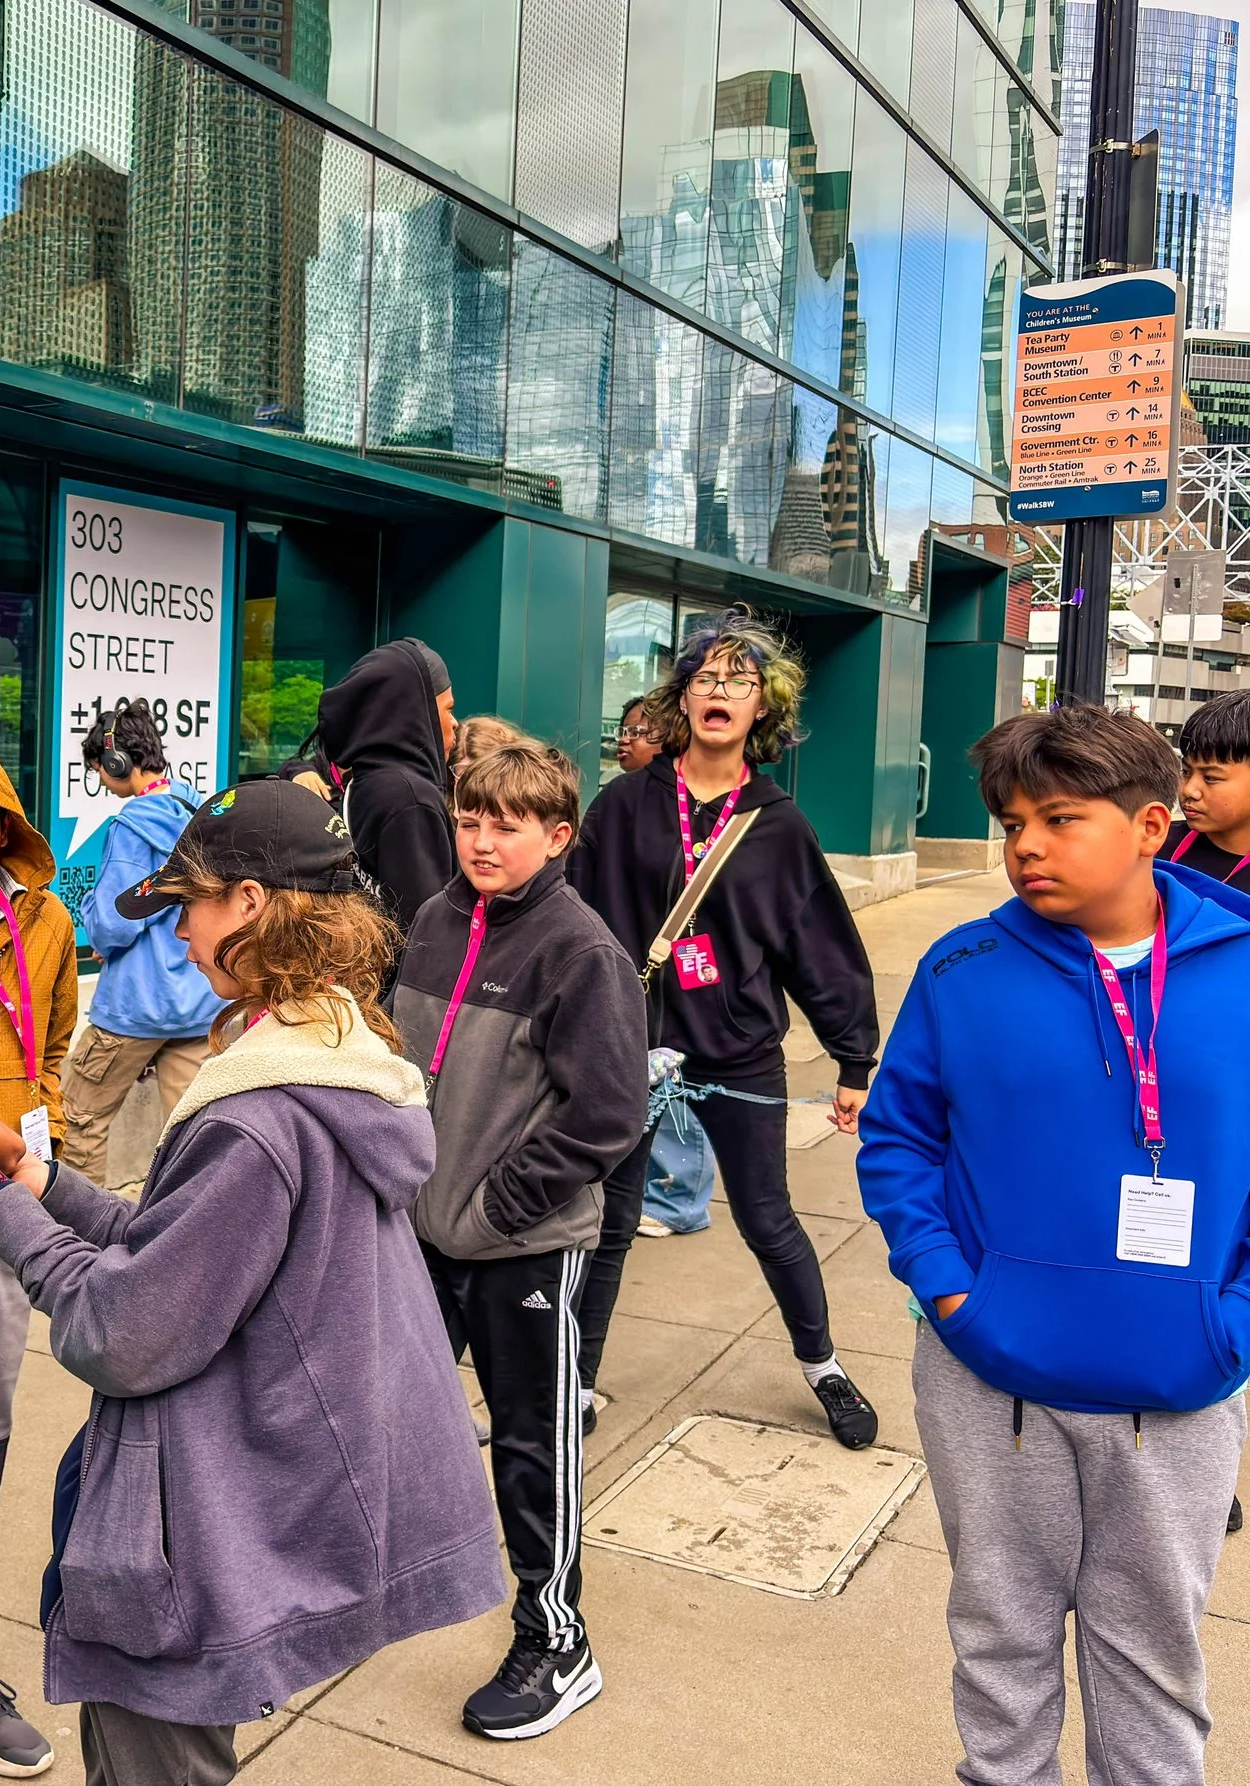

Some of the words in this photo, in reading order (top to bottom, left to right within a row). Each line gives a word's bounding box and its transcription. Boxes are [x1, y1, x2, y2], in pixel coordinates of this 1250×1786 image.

[1026, 310, 1044, 319] YOU
[1045, 307, 1061, 316] ARE
[1062, 306, 1073, 314] AT
[1075, 304, 1090, 312] THE
[1025, 318, 1061, 328] Children's
[1062, 314, 1092, 322] Museum
[1158, 322, 1163, 330] 1
[1025, 336, 1042, 345] Tea
[1044, 333, 1070, 345] Party
[1147, 332, 1162, 340] MIN
[1024, 344, 1066, 356] Museum
[1155, 350, 1161, 359] 7
[1024, 358, 1078, 372] Downtown
[1146, 359, 1161, 367] MIN
[1023, 371, 1051, 382] South
[1053, 367, 1089, 378] Station
[1153, 376, 1160, 385] 9
[1022, 387, 1047, 398] BCEC
[1145, 386, 1160, 394] MIN
[1022, 397, 1077, 408] Convention
[1079, 392, 1112, 402] Center
[1148, 403, 1158, 412] 14
[1021, 411, 1075, 424] Downtown
[1144, 413, 1158, 421] MIN
[1021, 422, 1062, 433] Crossing
[1147, 431, 1158, 440] 16
[1020, 438, 1081, 451] Government
[1082, 436, 1100, 446] Ctr.
[1142, 440, 1157, 448] MIN
[1056, 448, 1076, 456] Green
[1078, 446, 1092, 454] Line
[1019, 465, 1047, 475] North
[1048, 461, 1084, 472] Station
[1145, 458, 1156, 467] 25
[1141, 467, 1156, 475] MIN
[1018, 474, 1044, 483] Orange
[1018, 480, 1053, 489] Commuter
[1073, 475, 1099, 484] Amtrak
[1017, 500, 1055, 510] #WalkSBW
[71, 510, 123, 555] 303
[70, 571, 214, 624] CONGRESS
[68, 632, 175, 675] STREET
[175, 699, 210, 737] SF
[67, 762, 109, 797] FO
[932, 938, 998, 974] POLO
[1102, 969, 1116, 982] EF
[1114, 1002, 1127, 1016] EF
[1147, 1071, 1156, 1085] EF
[1146, 1105, 1158, 1121] EF
[521, 1300, 552, 1309] adidas
